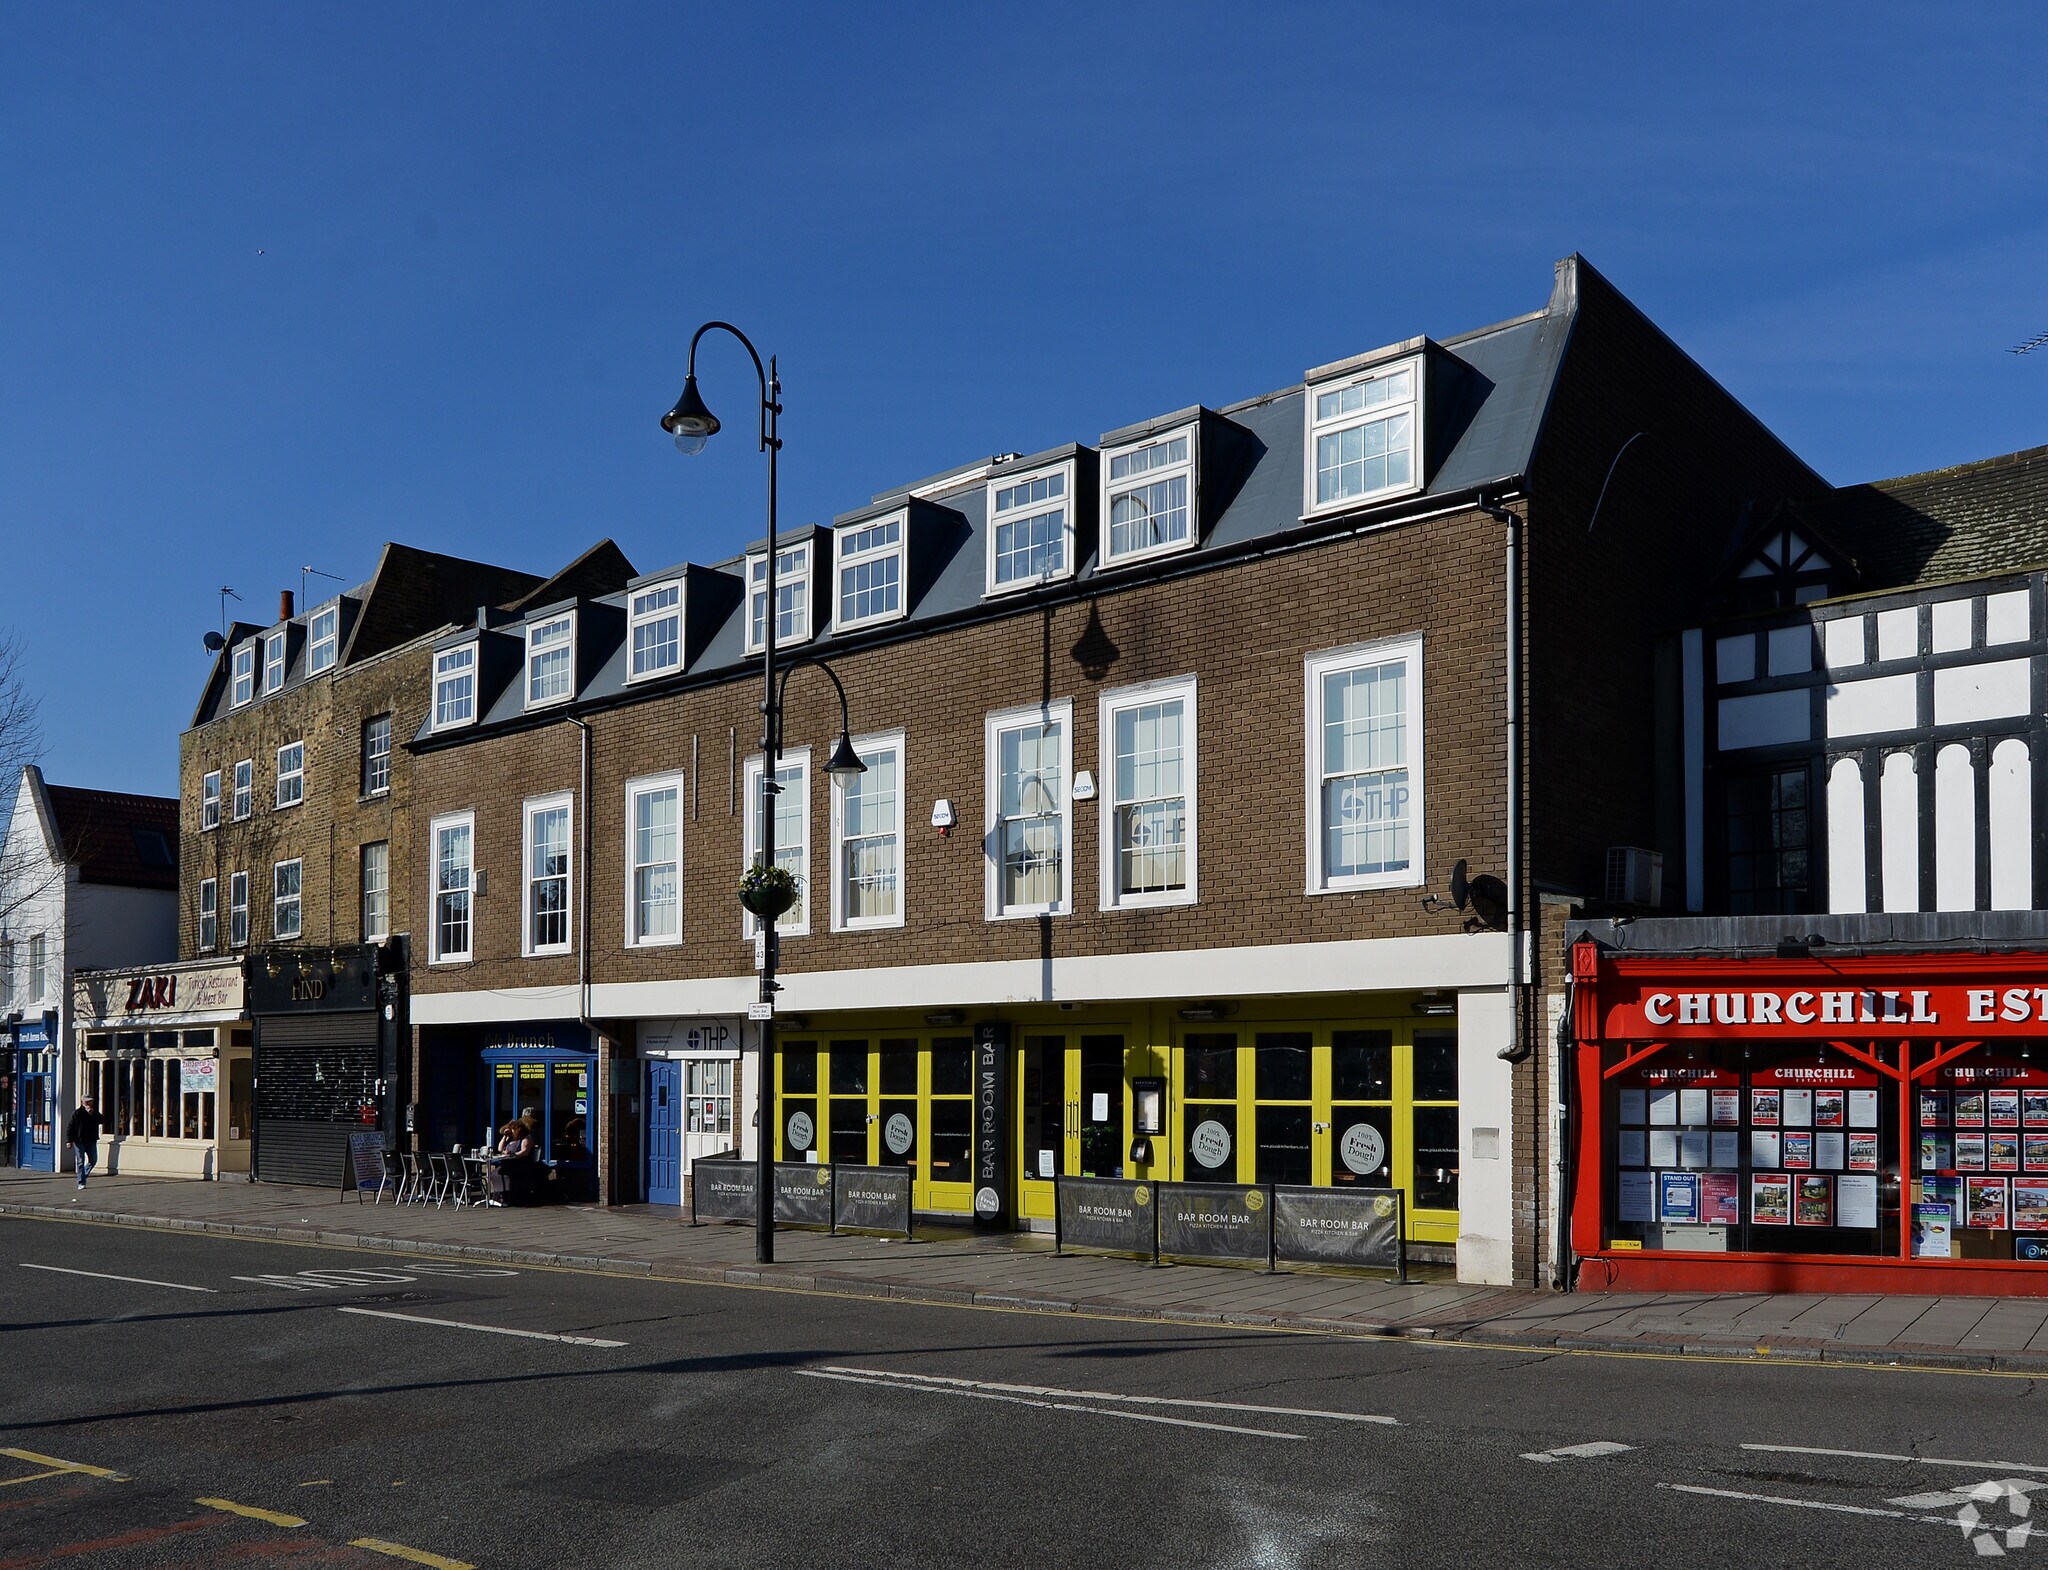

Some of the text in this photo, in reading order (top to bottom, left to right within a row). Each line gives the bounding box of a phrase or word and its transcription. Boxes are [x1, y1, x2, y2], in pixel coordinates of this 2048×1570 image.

[1074, 785, 1092, 794] SECOM
[1364, 786, 1409, 820] THP
[125, 975, 178, 1010] ZAKI
[1644, 990, 1938, 1024] CHURCHILL
[507, 1032, 555, 1048] Brunch
[701, 1026, 728, 1050] THP
[1641, 1068, 1718, 1078] CHURCHILL
[1775, 1068, 1855, 1078] CHURCHILL
[1945, 1068, 2029, 1077] CHURCHILL
[982, 1027, 995, 1179] BAR ROOM BAR
[891, 1124, 908, 1136] Fresh
[1207, 1128, 1220, 1137] 100%
[1357, 1131, 1373, 1141] 100%
[890, 1132, 907, 1144] Dough
[1200, 1133, 1224, 1148] Fresh
[1198, 1142, 1222, 1156] Dough
[1350, 1138, 1377, 1153] Fresh
[1348, 1146, 1375, 1162] Dough
[781, 1186, 824, 1196] BAR ROOM BAR
[883, 1192, 896, 1200] BAR
[1079, 1205, 1132, 1218] BAR ROOM BAR
[1178, 1213, 1249, 1224] BAR ROOM BAR
[1300, 1219, 1369, 1231] BAR ROOM BAR
